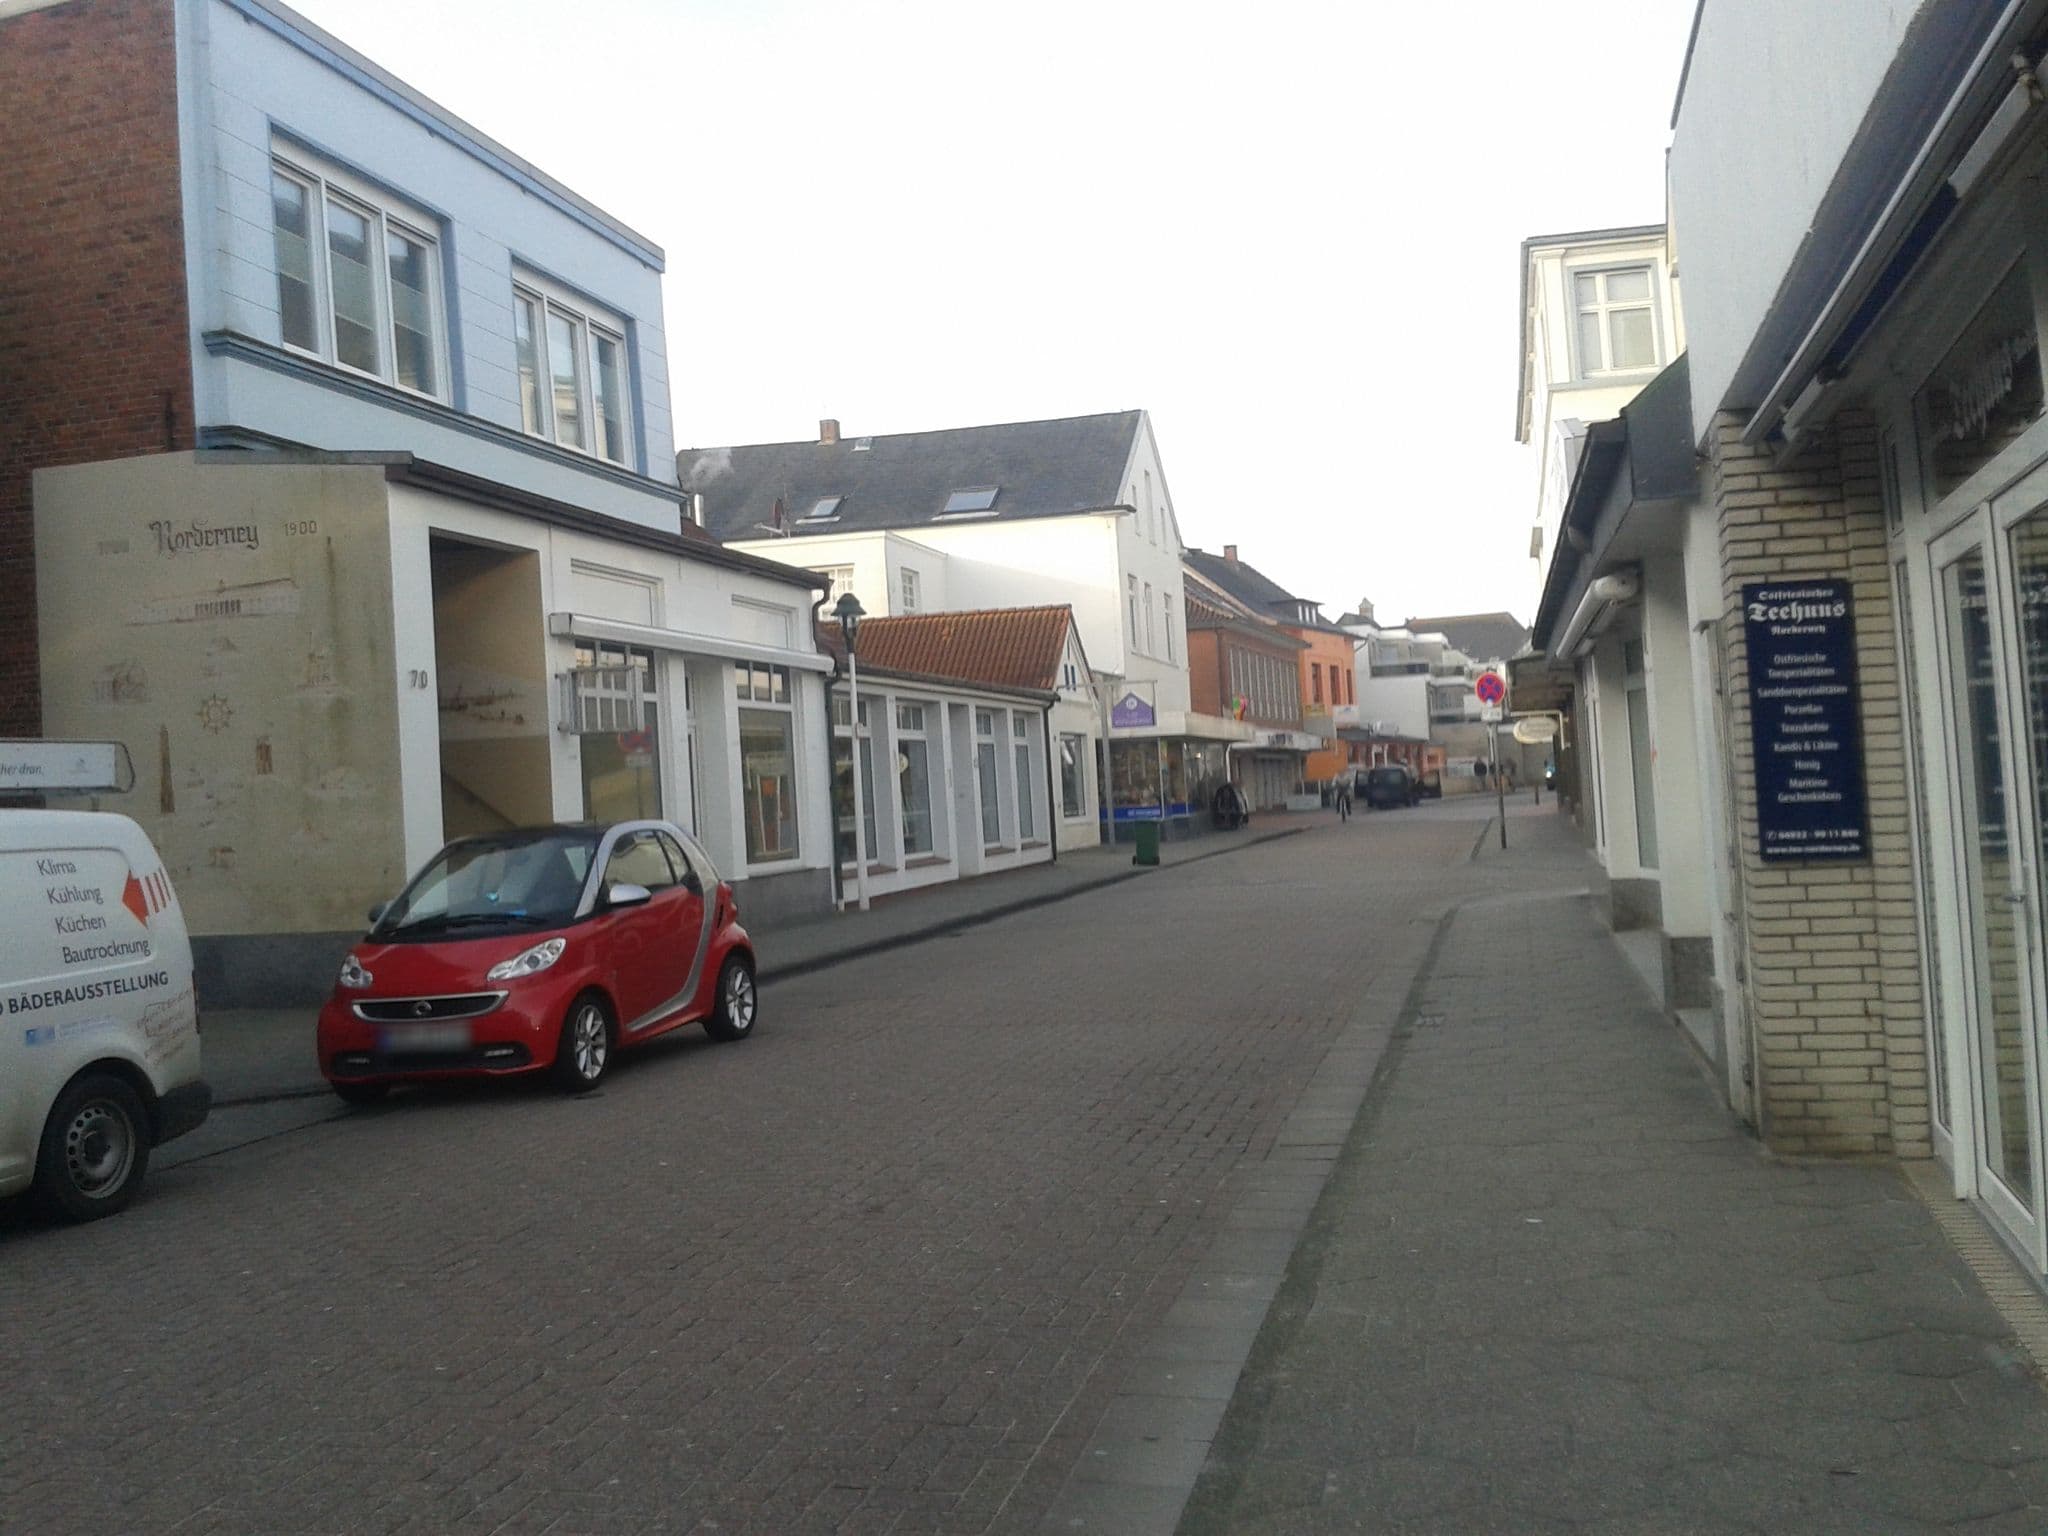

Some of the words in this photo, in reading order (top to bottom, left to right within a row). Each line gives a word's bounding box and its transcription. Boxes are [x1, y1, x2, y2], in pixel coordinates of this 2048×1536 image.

[149, 519, 260, 553] Norderney
[284, 521, 318, 537] 1900
[408, 670, 428, 689] 70
[1804, 741, 1811, 751] &
[1795, 760, 1820, 771] Honig
[36, 859, 77, 877] Klima
[46, 885, 104, 906] Kühlung
[54, 914, 107, 935] Küchen
[62, 940, 151, 964] Bautrocknung
[8, 970, 169, 1014] BÄDERAUSSTELLUNG
